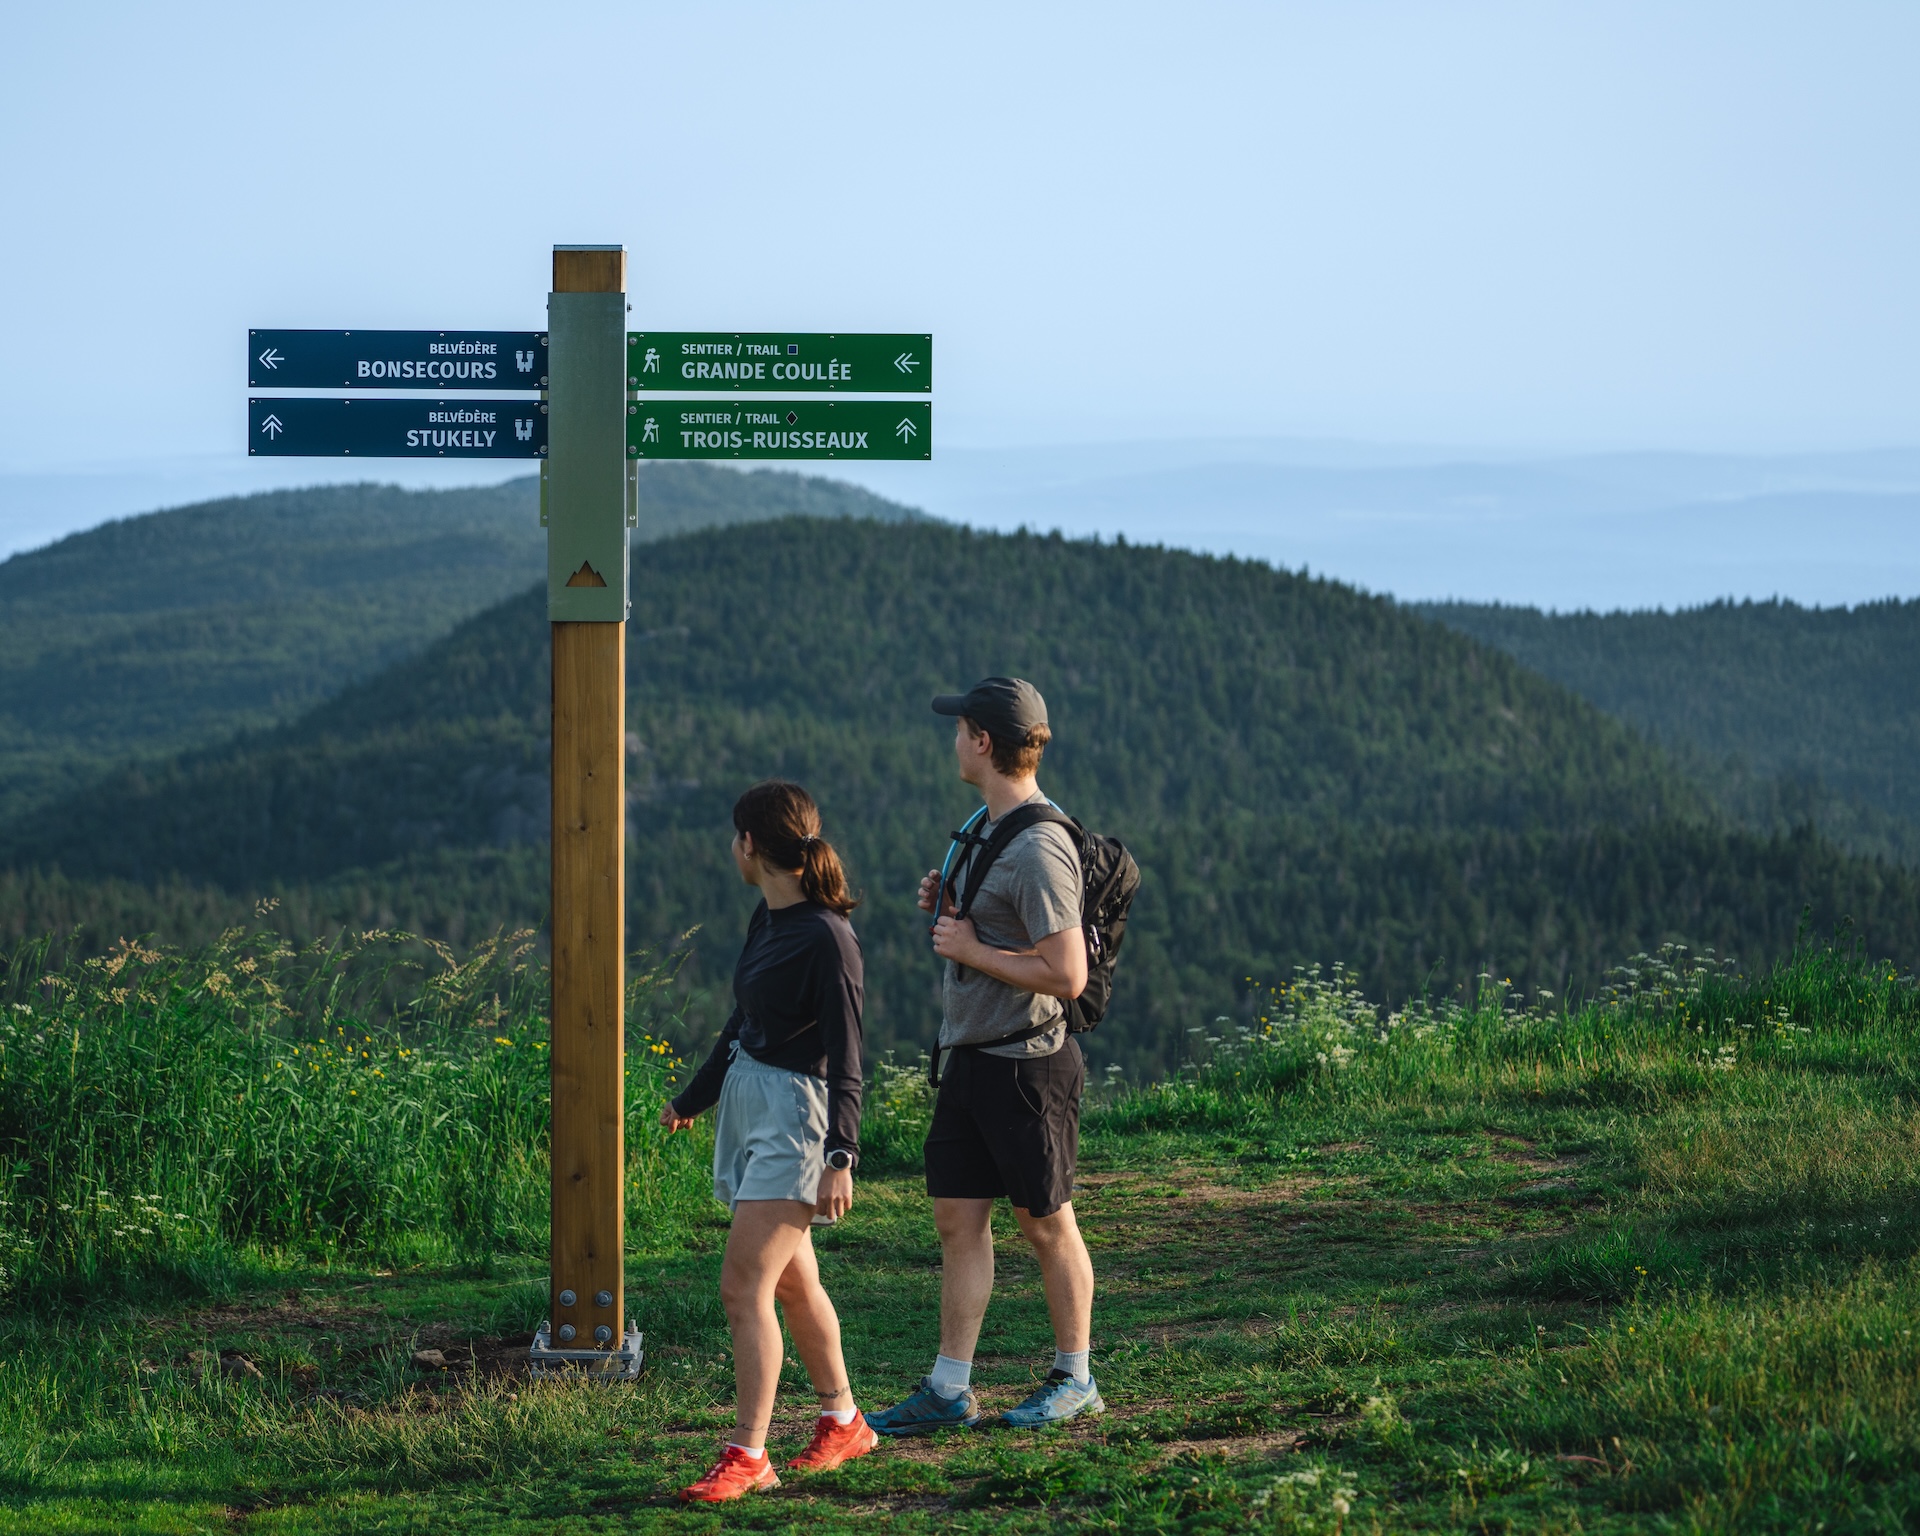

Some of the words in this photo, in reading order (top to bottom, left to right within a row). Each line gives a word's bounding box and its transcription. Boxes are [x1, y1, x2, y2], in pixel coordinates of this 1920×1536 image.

[430, 341, 497, 355] BELVÉDÈRE
[681, 343, 732, 355] SENTIER
[736, 343, 742, 356] /
[746, 344, 781, 356] TRAIL
[357, 360, 497, 379] BONSECOURS
[681, 361, 765, 380] GRANDE
[772, 358, 852, 381] COULÉE
[429, 409, 496, 423] BELVÉDÈRE
[680, 413, 731, 424] SENTIER
[735, 412, 741, 425] /
[745, 413, 780, 425] TRAIL
[406, 429, 496, 447] STUKELY
[680, 431, 869, 449] TROIS-RUISSEAUX
